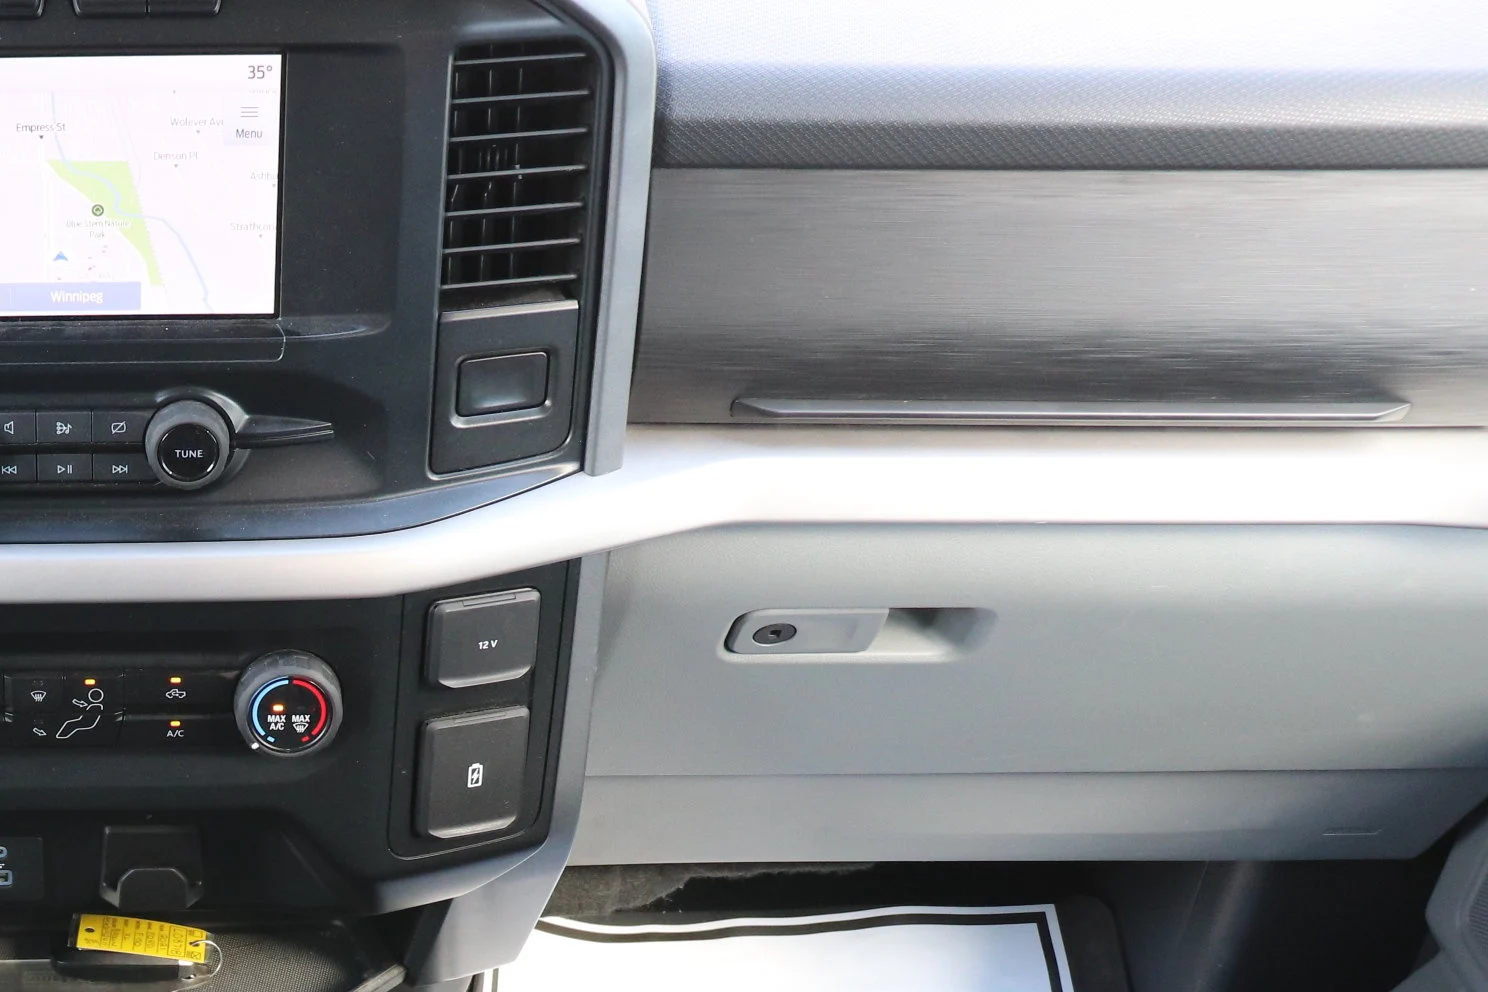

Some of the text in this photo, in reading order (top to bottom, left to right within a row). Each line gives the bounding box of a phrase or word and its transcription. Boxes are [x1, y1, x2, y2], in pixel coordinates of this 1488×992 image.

[247, 64, 273, 80] 35°
[15, 122, 66, 134] Empress St
[235, 128, 263, 139] Menu
[50, 290, 103, 304] Winnipeg
[174, 448, 204, 458] TUNE
[478, 639, 498, 650] 12 V
[267, 714, 286, 724] MAX
[292, 714, 311, 723] MAX
[269, 722, 285, 731] A/C
[166, 729, 184, 738] A/C
